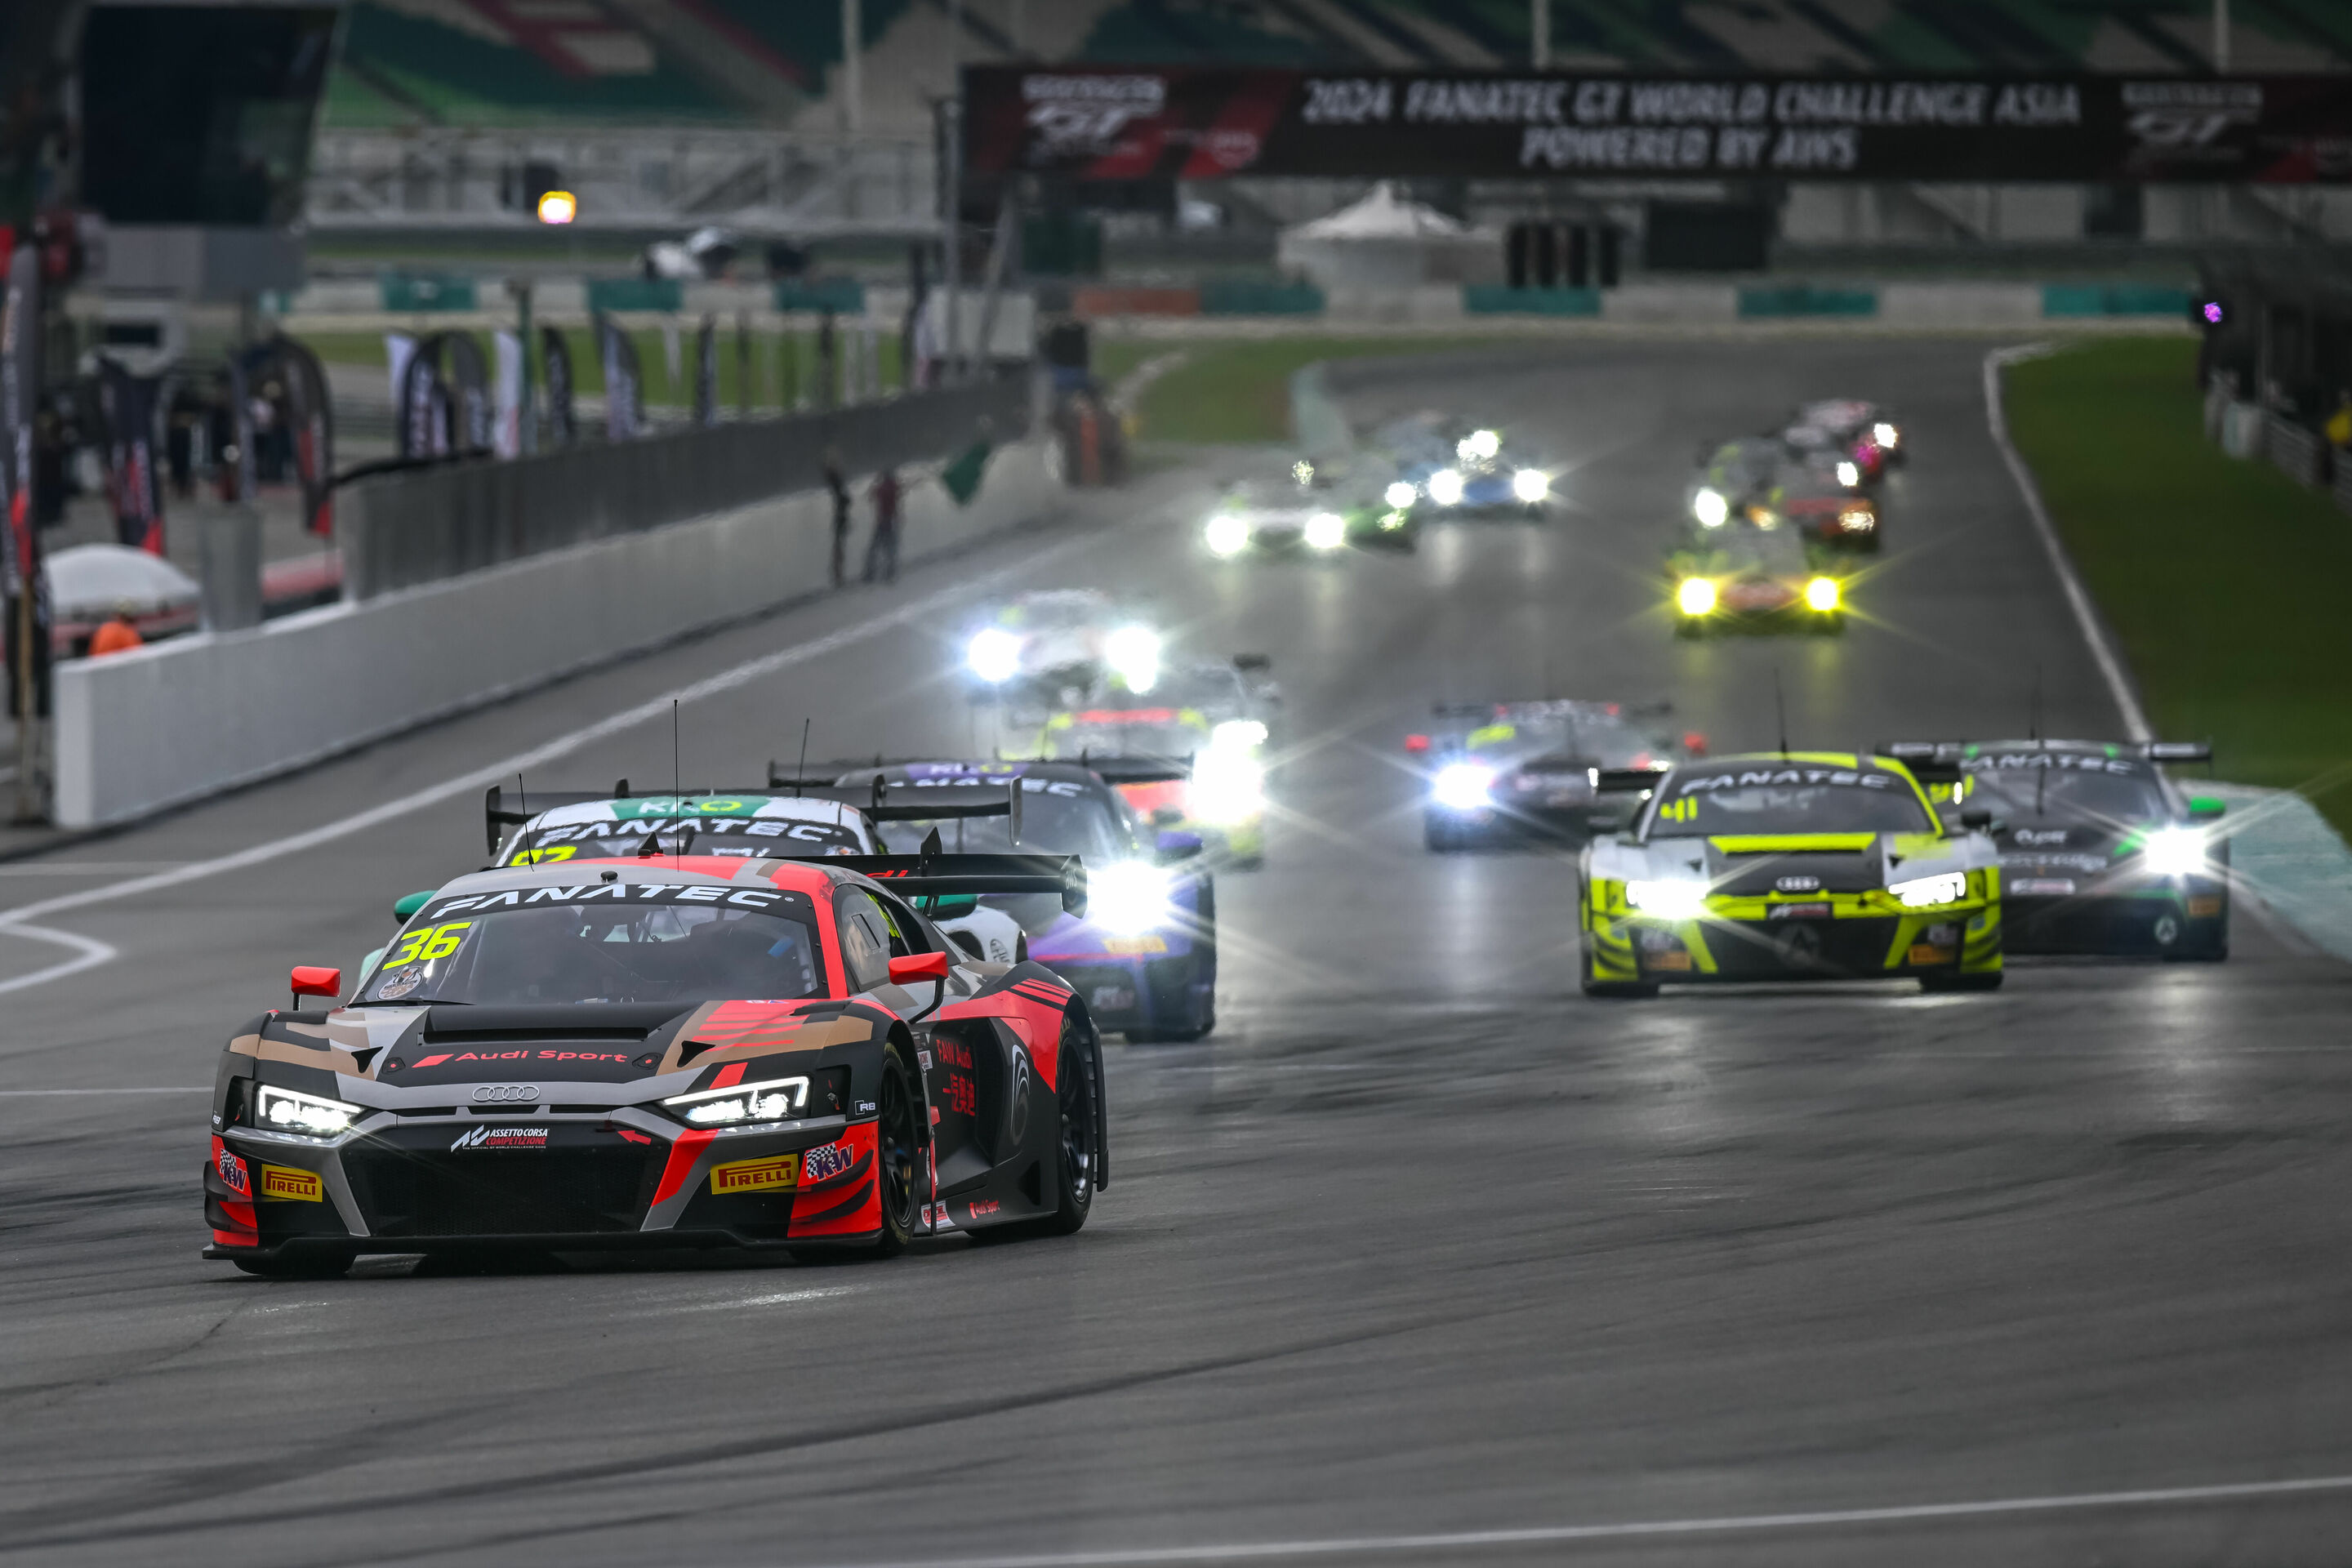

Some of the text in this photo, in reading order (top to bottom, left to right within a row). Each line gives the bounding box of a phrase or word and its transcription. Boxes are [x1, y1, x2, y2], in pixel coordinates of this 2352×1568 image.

[1304, 79, 1392, 122] 2024
[1405, 80, 1568, 122] FANATEC
[1631, 82, 1769, 122] WORLD
[1773, 83, 1989, 124] CHALLENGE
[1993, 85, 2082, 125] ASIA
[1519, 125, 1860, 169] POWERED BY AWS
[1680, 770, 1888, 794] FANATEC
[535, 817, 832, 849] FANATEC
[430, 884, 782, 919] FANATEC
[381, 921, 472, 971] 36
[455, 1050, 628, 1062] Audi Sport
[486, 1136, 547, 1146] COMPETIZIONE
[490, 1128, 548, 1138] ASSETTO CORSA
[718, 1160, 791, 1188] PIRELLI
[817, 1143, 854, 1182] KW
[265, 1169, 317, 1196] PIRELLI
